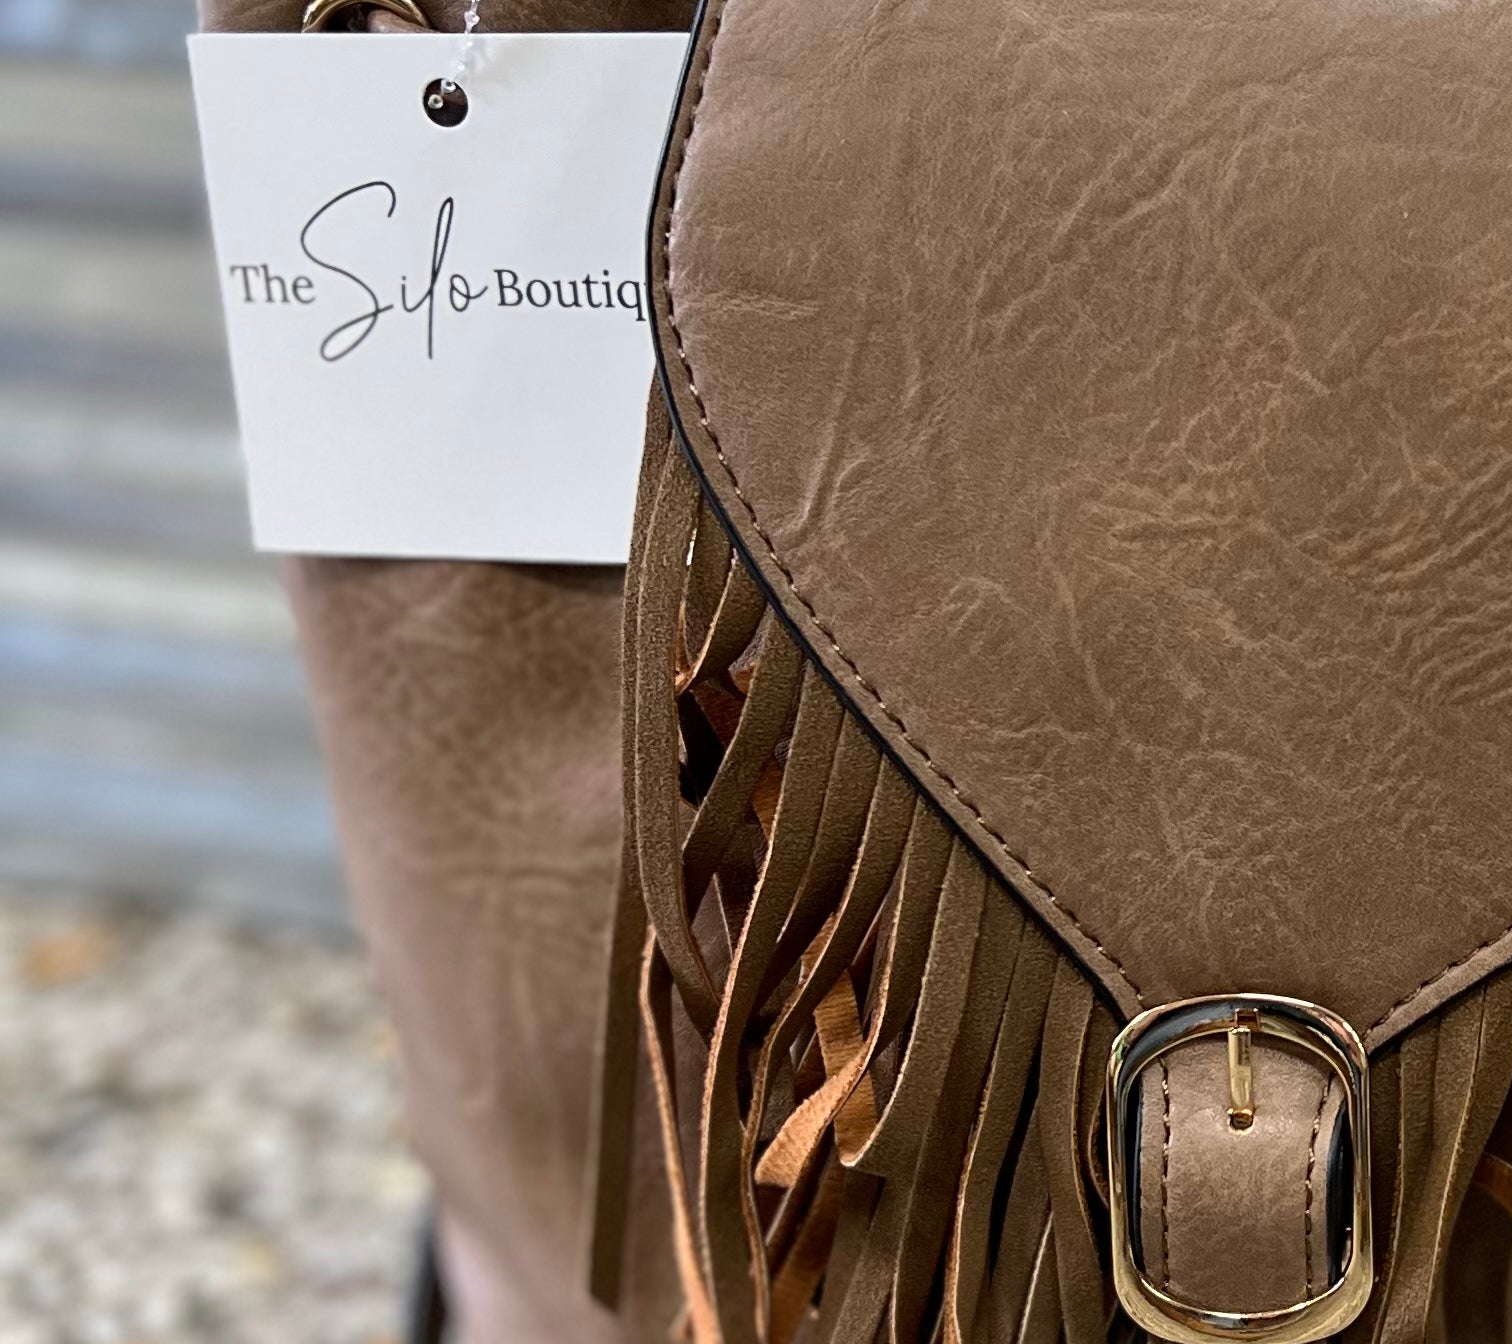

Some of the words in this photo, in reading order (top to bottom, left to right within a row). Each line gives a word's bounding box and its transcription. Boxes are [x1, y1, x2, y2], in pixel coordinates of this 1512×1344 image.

[230, 264, 315, 304] The
[301, 181, 488, 362] Silo
[494, 268, 647, 322] Boutiq
